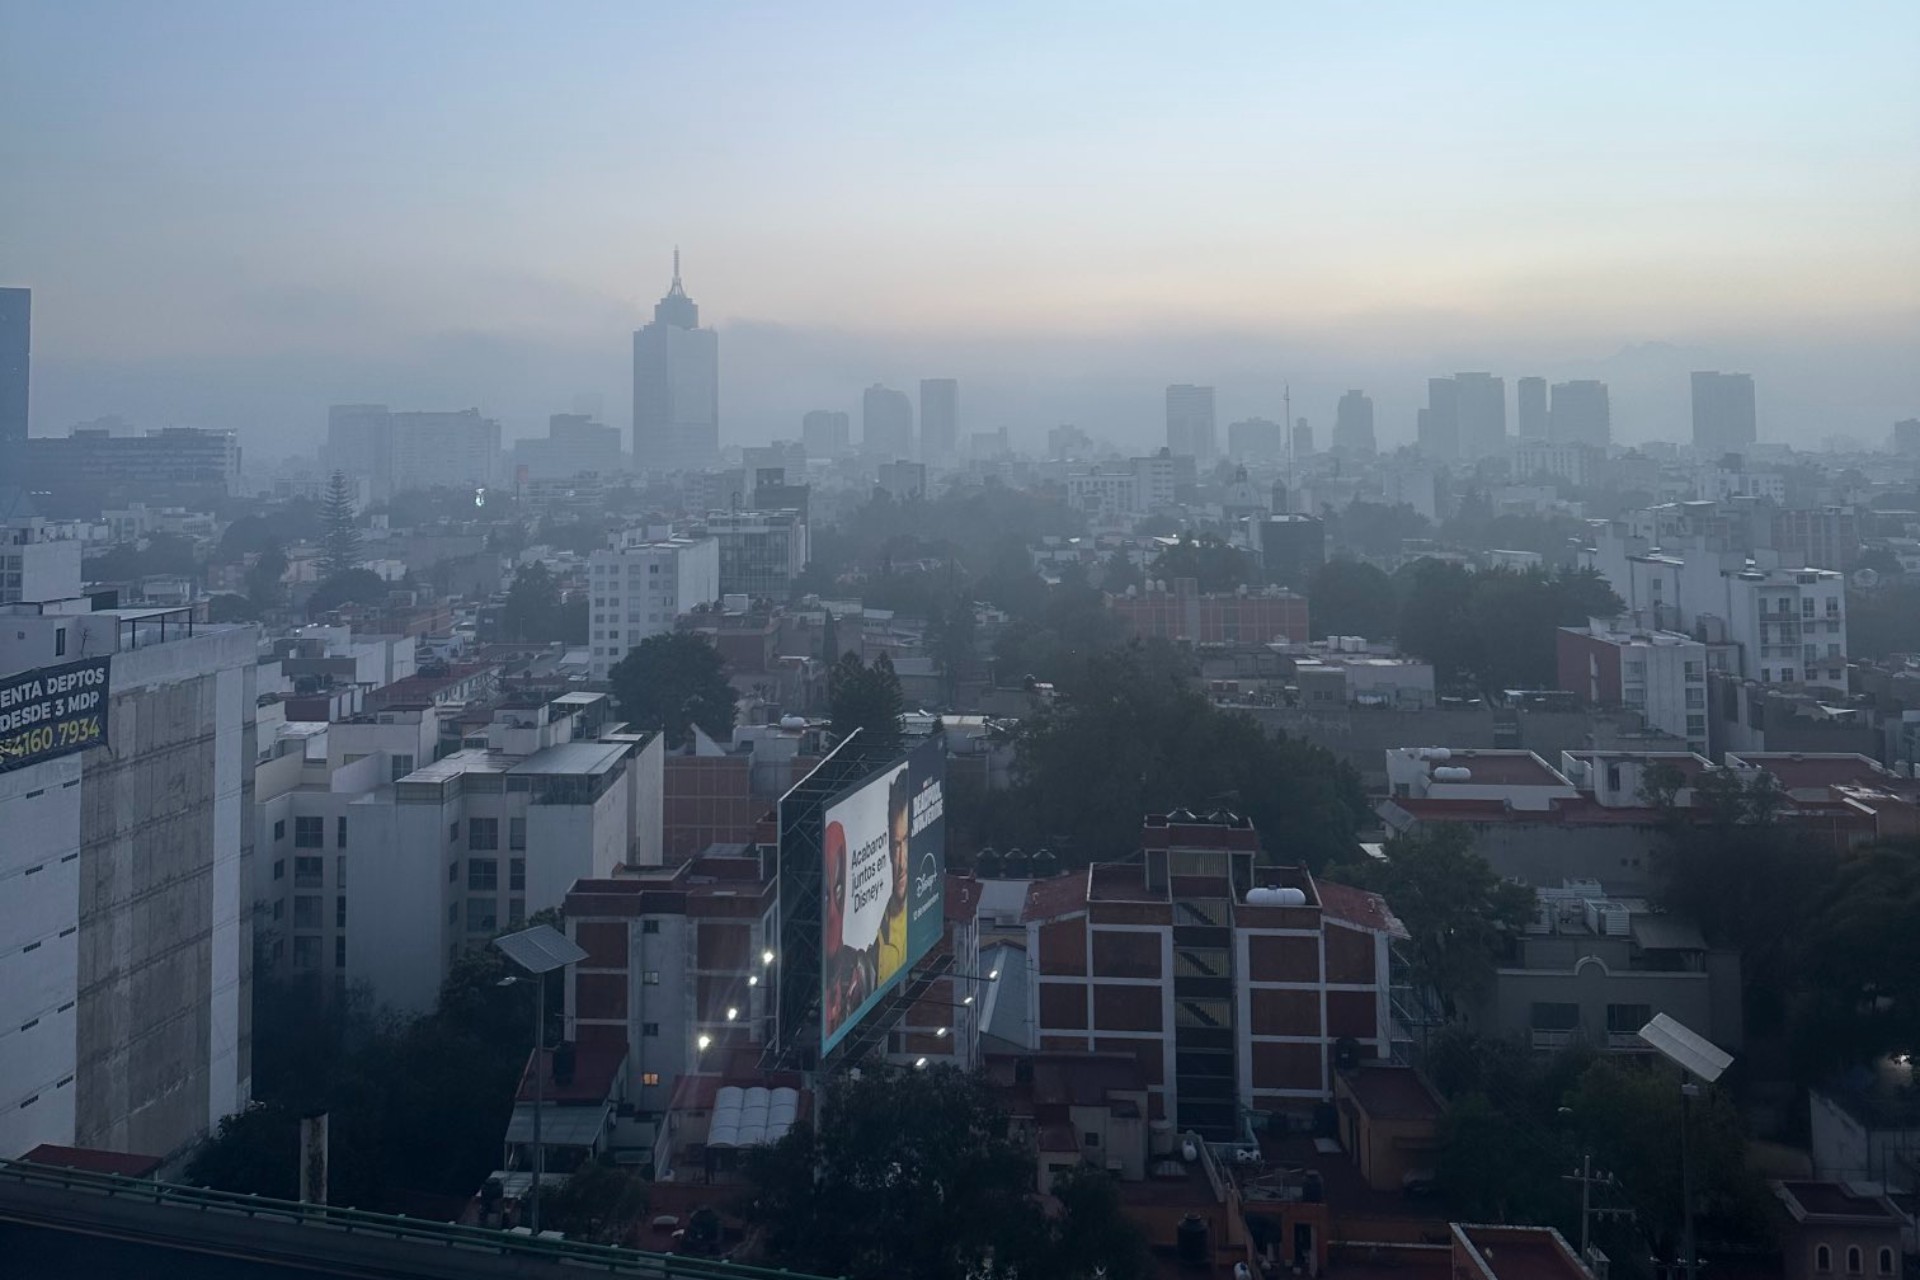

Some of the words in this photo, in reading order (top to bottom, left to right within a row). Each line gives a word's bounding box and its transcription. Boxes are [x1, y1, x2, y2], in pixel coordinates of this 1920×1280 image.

[46, 667, 105, 695] DEPTOS
[0, 701, 51, 732] DESDE
[55, 698, 65, 717] 3
[68, 691, 100, 713] MDP
[851, 831, 887, 870] Acabaron
[851, 862, 876, 898] juntos
[877, 853, 886, 872] en
[854, 880, 884, 914] Disney+
